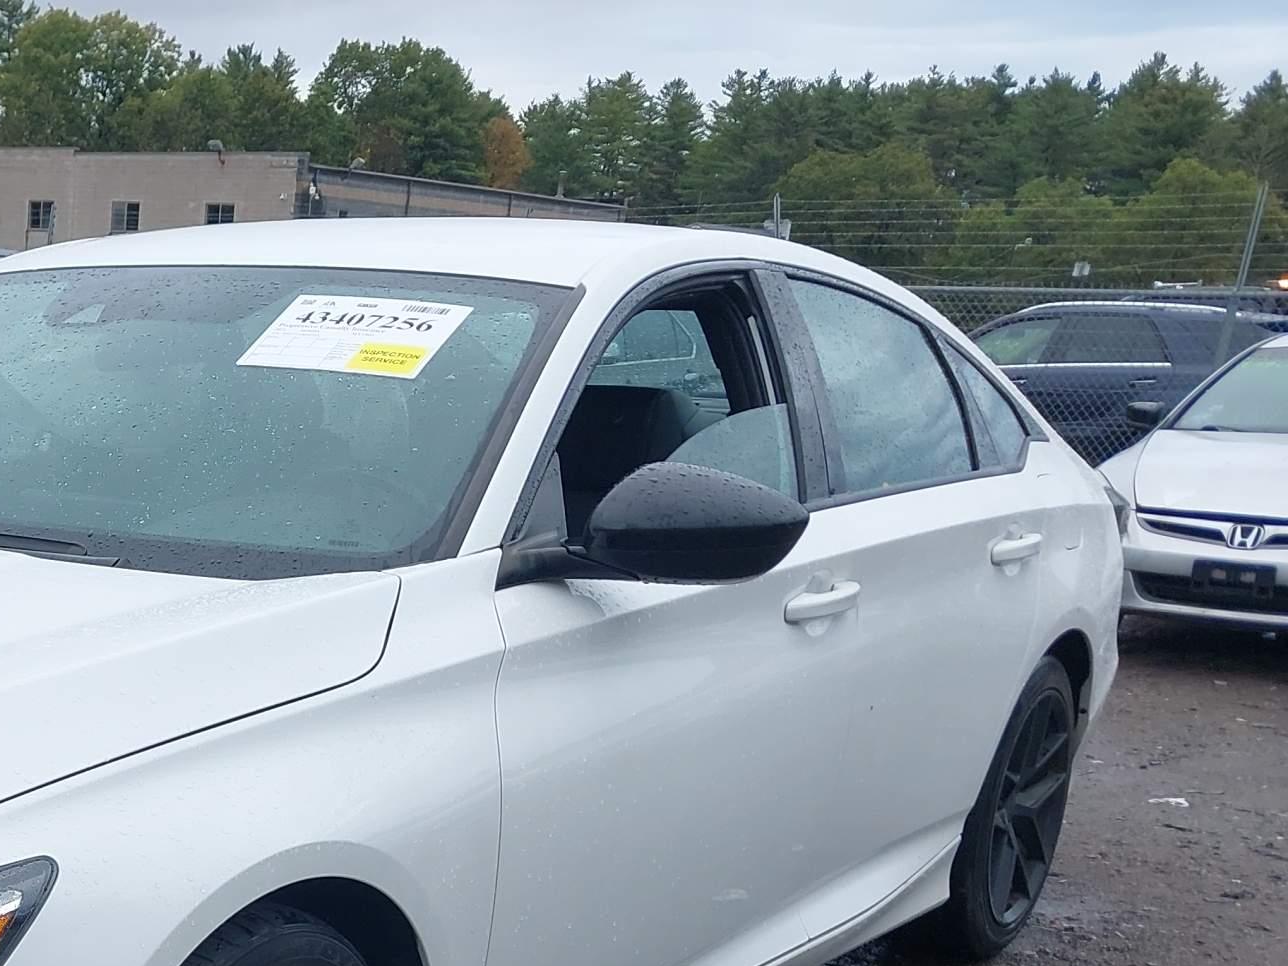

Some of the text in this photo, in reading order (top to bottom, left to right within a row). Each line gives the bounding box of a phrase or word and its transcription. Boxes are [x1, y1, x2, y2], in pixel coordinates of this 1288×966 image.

[295, 311, 436, 332] 43407256
[359, 349, 421, 360] INSPECTION
[361, 356, 408, 366] SERVICE
